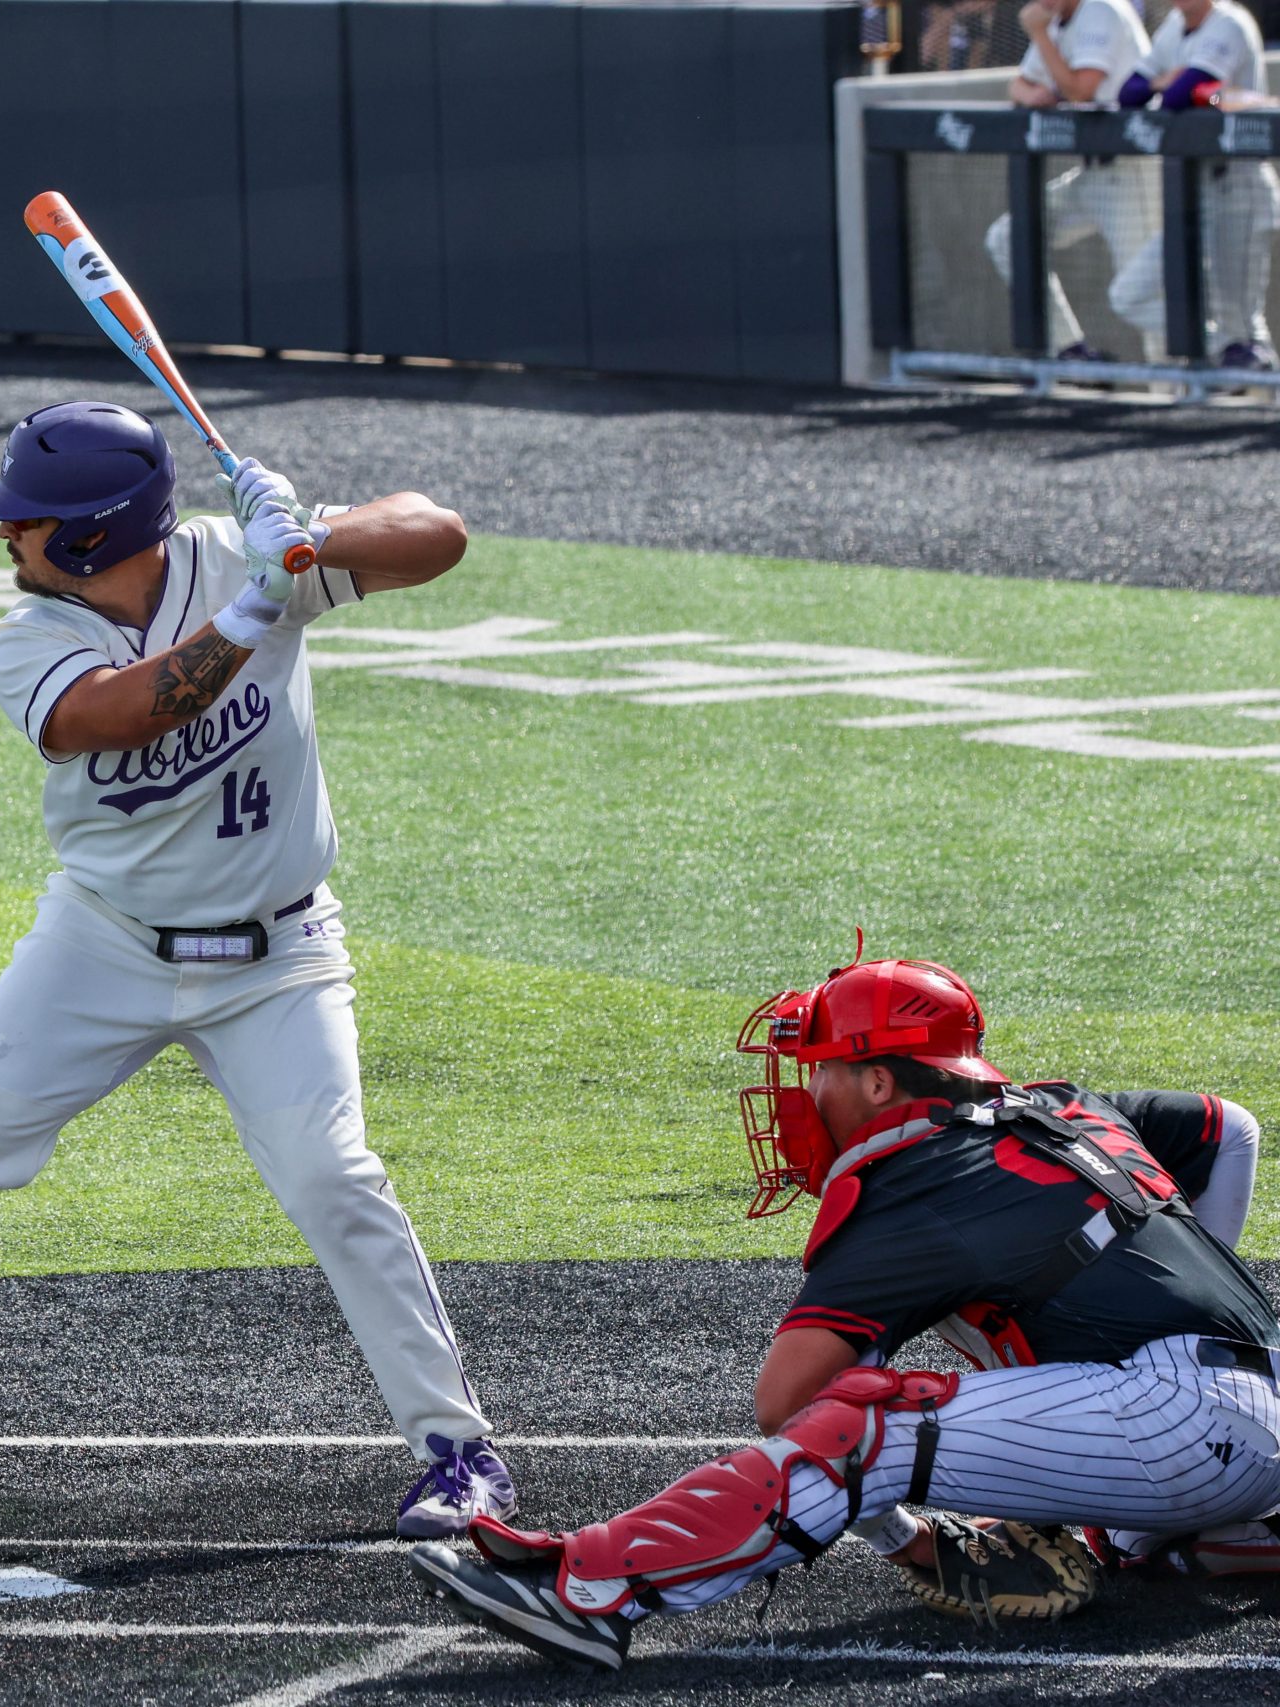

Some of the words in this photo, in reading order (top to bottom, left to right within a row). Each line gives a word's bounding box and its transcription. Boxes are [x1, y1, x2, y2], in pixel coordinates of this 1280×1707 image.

[94, 499, 130, 520] EASTON
[216, 766, 271, 839] 14
[1069, 1142, 1117, 1176] rucci
